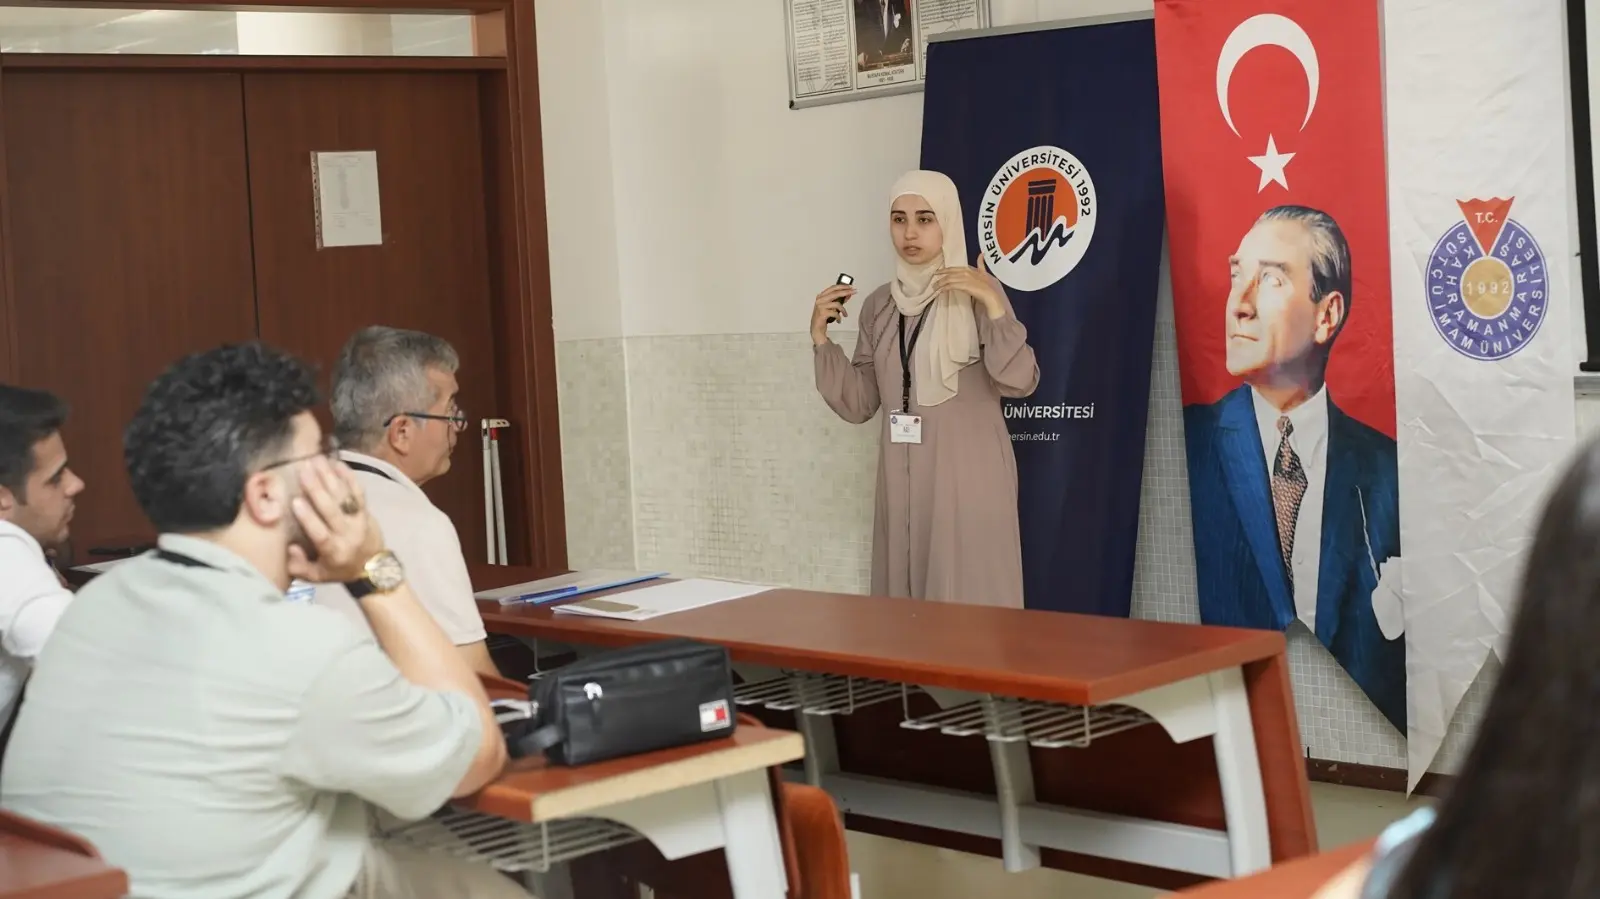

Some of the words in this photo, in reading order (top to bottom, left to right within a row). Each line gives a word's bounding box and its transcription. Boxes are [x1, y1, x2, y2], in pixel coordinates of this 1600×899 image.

[991, 150, 1082, 196] ÜNİVERSİTESİ
[1076, 179, 1091, 216] 1992
[982, 201, 1001, 264] MERSİN
[1475, 212, 1498, 223] T.C.
[1446, 242, 1528, 335] KAHRAMANMARAŞ
[1466, 282, 1509, 296] 1992
[1004, 402, 1094, 418] ÜNİVERSİTESİ
